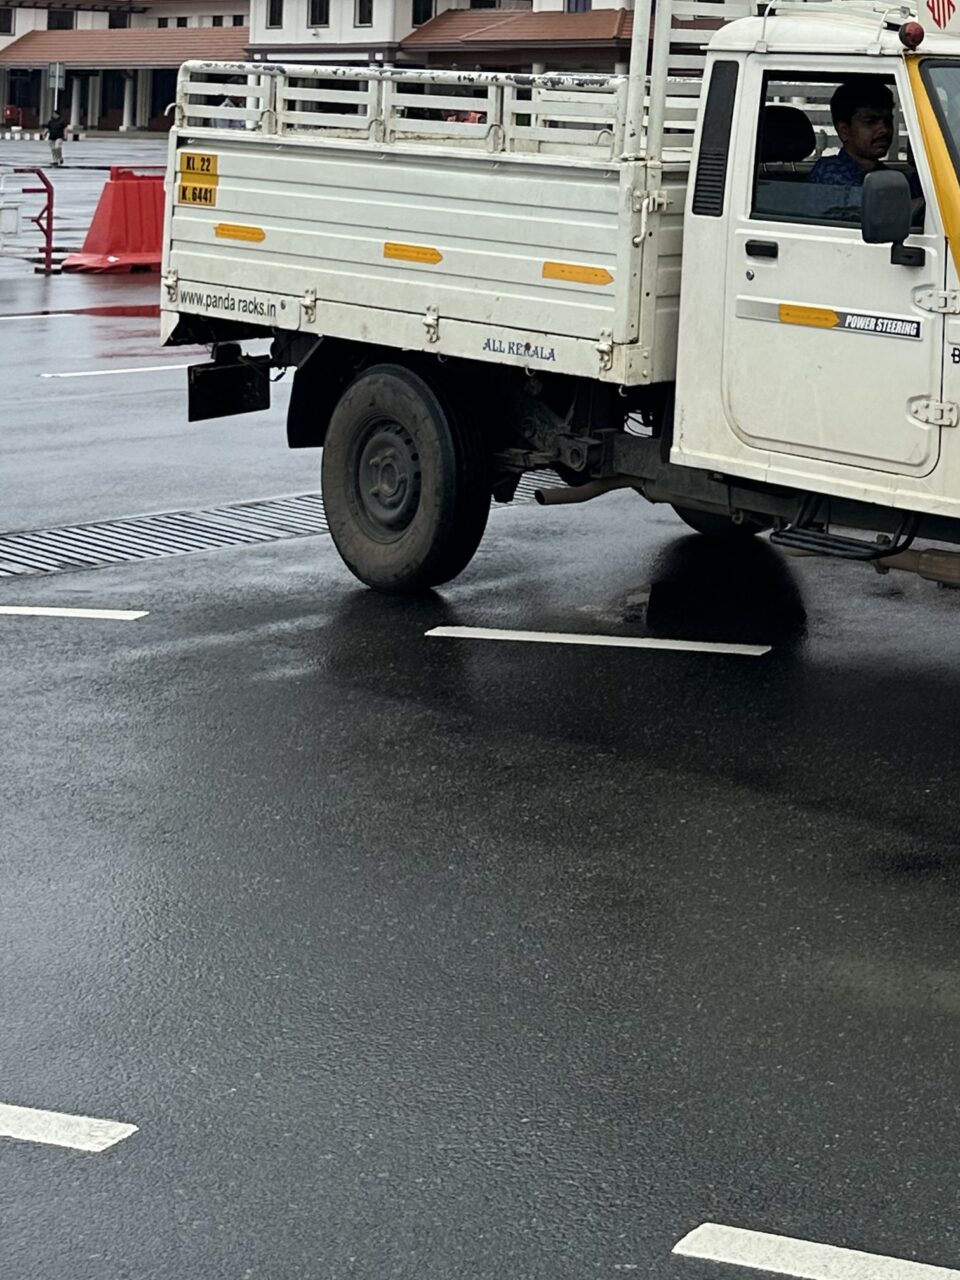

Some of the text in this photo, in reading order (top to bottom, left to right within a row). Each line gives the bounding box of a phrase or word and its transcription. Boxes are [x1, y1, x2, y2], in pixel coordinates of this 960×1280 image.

[238, 297, 276, 317] racks.in
[844, 314, 918, 336] POWER STEERING
[483, 338, 556, 362] ALL KERALA
